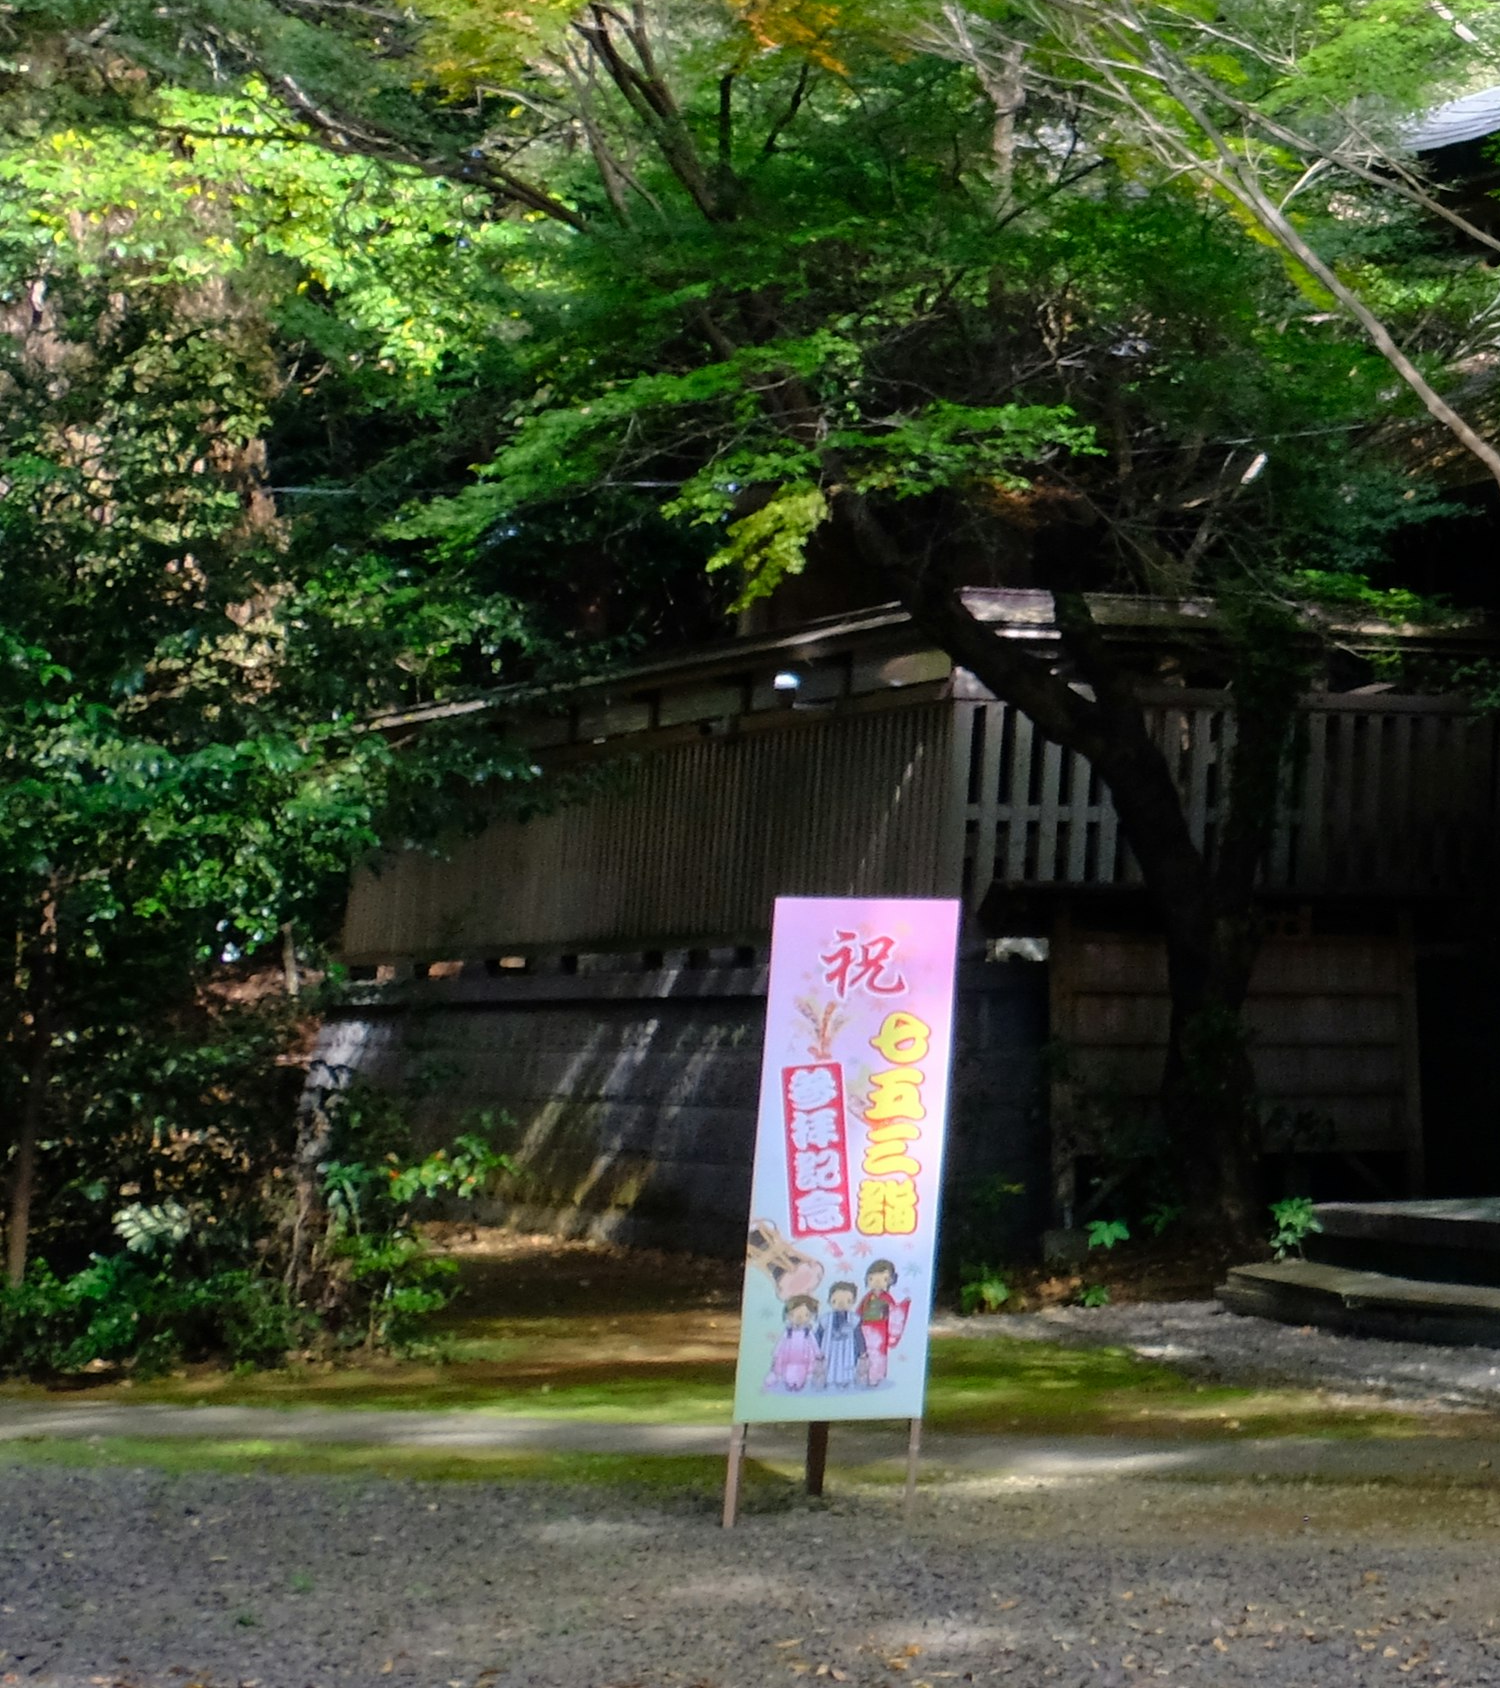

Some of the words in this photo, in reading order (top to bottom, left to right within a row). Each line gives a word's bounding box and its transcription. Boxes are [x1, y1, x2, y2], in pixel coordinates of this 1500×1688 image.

[820, 929, 906, 998] 祝
[787, 1066, 846, 1233] 参拝記念
[856, 1010, 931, 1235] 七五三詣
